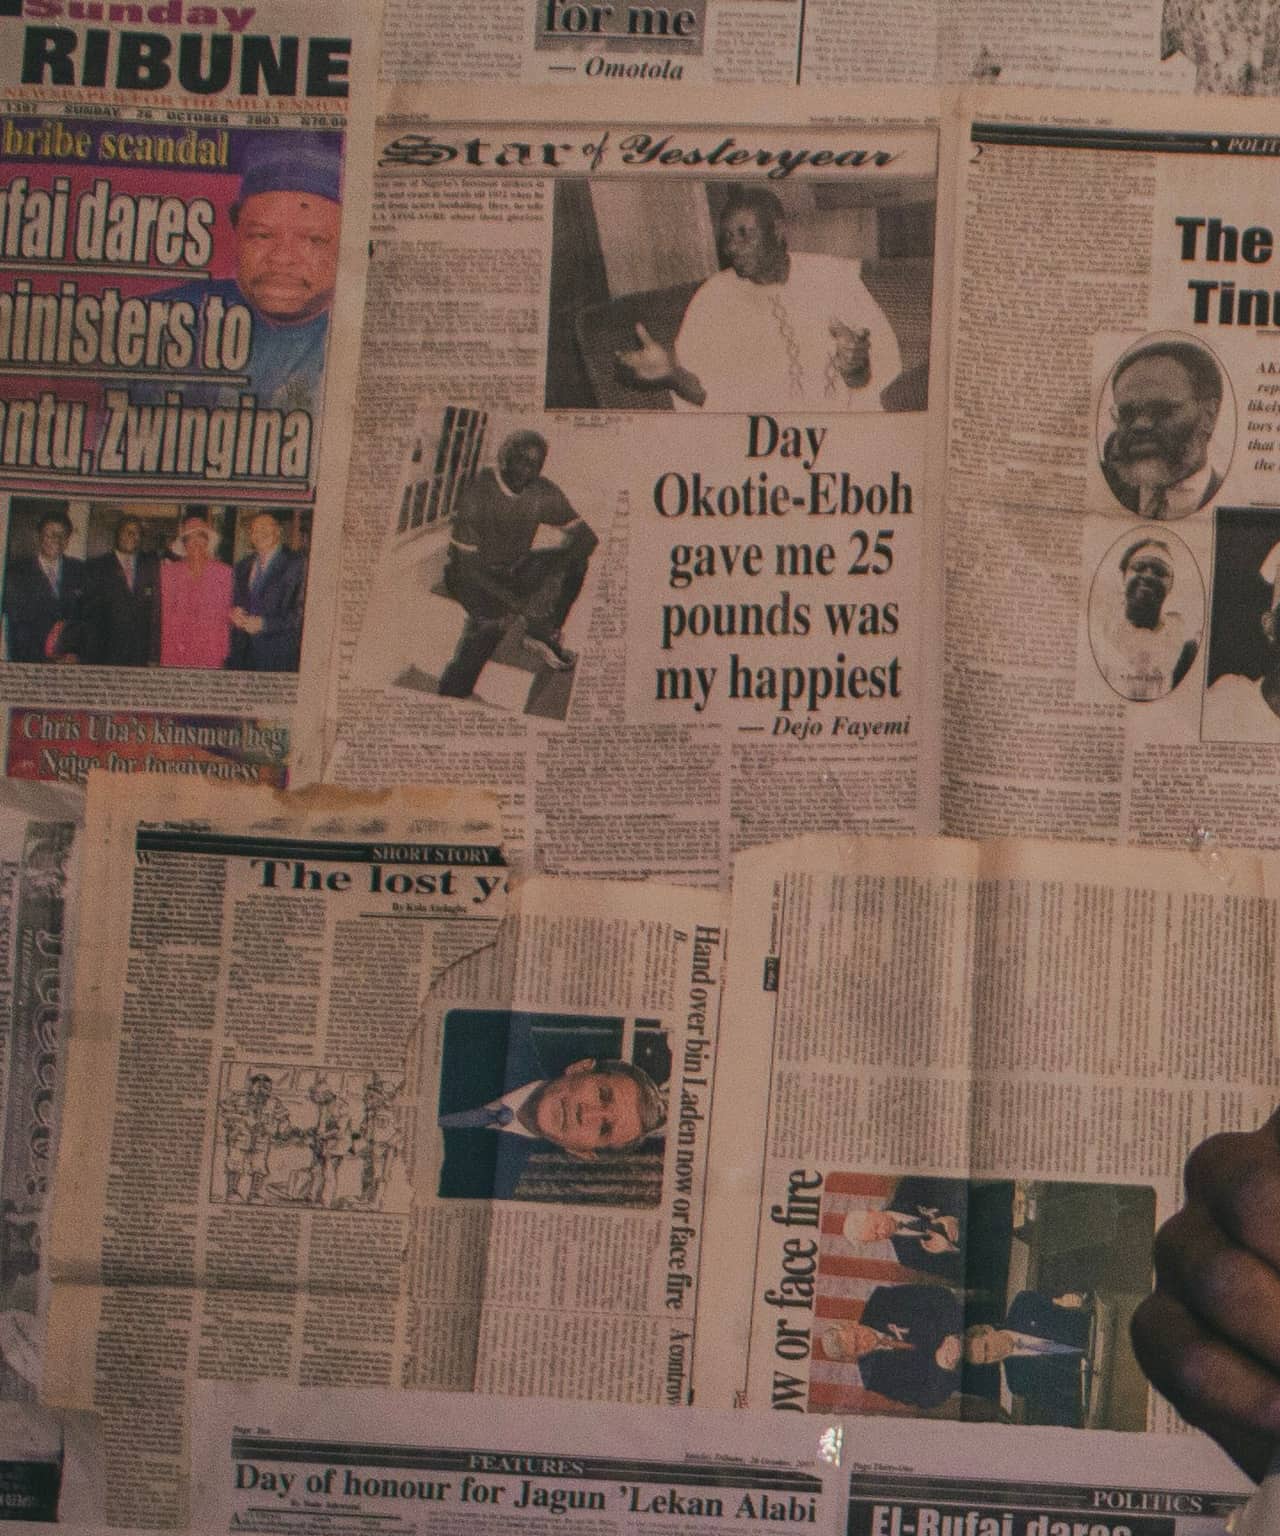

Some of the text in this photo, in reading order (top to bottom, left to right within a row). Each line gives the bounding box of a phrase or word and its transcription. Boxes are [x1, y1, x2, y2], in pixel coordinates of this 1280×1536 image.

[24, 0, 257, 32] Sunday
[545, 0, 697, 37] for me
[20, 25, 352, 98] RIBUNE
[585, 56, 686, 82] Omotola
[4, 120, 230, 168] bribe scandal
[377, 131, 901, 180] Star of Yesteryear
[0, 176, 214, 266] fai dares
[1175, 216, 1273, 264] The
[203, 297, 254, 371] to
[0, 388, 312, 487] ntu, Zwingina
[747, 414, 828, 469] Day
[1247, 420, 1272, 433] tors
[1247, 439, 1276, 452] that
[1254, 458, 1276, 473] the
[654, 471, 914, 518] Okotie-Eboh
[669, 528, 896, 588] gave me 25
[661, 590, 900, 650] pounds was
[655, 652, 903, 713] my happiest
[22, 712, 83, 743] Chris
[152, 717, 244, 750] kinsmen
[246, 725, 289, 755] beg
[771, 715, 912, 741] Dejo Fayemi
[249, 858, 458, 897] The lost
[372, 846, 491, 864] SHORT STORY
[665, 923, 722, 1311] Hand over bin Laden now or face fire
[764, 1168, 824, 1363] fire face or
[468, 1454, 587, 1476] FEATURES
[234, 1463, 817, 1523] Day of honour for Jagun 'Lekan Alabi
[1092, 1489, 1204, 1514] POLITICS
